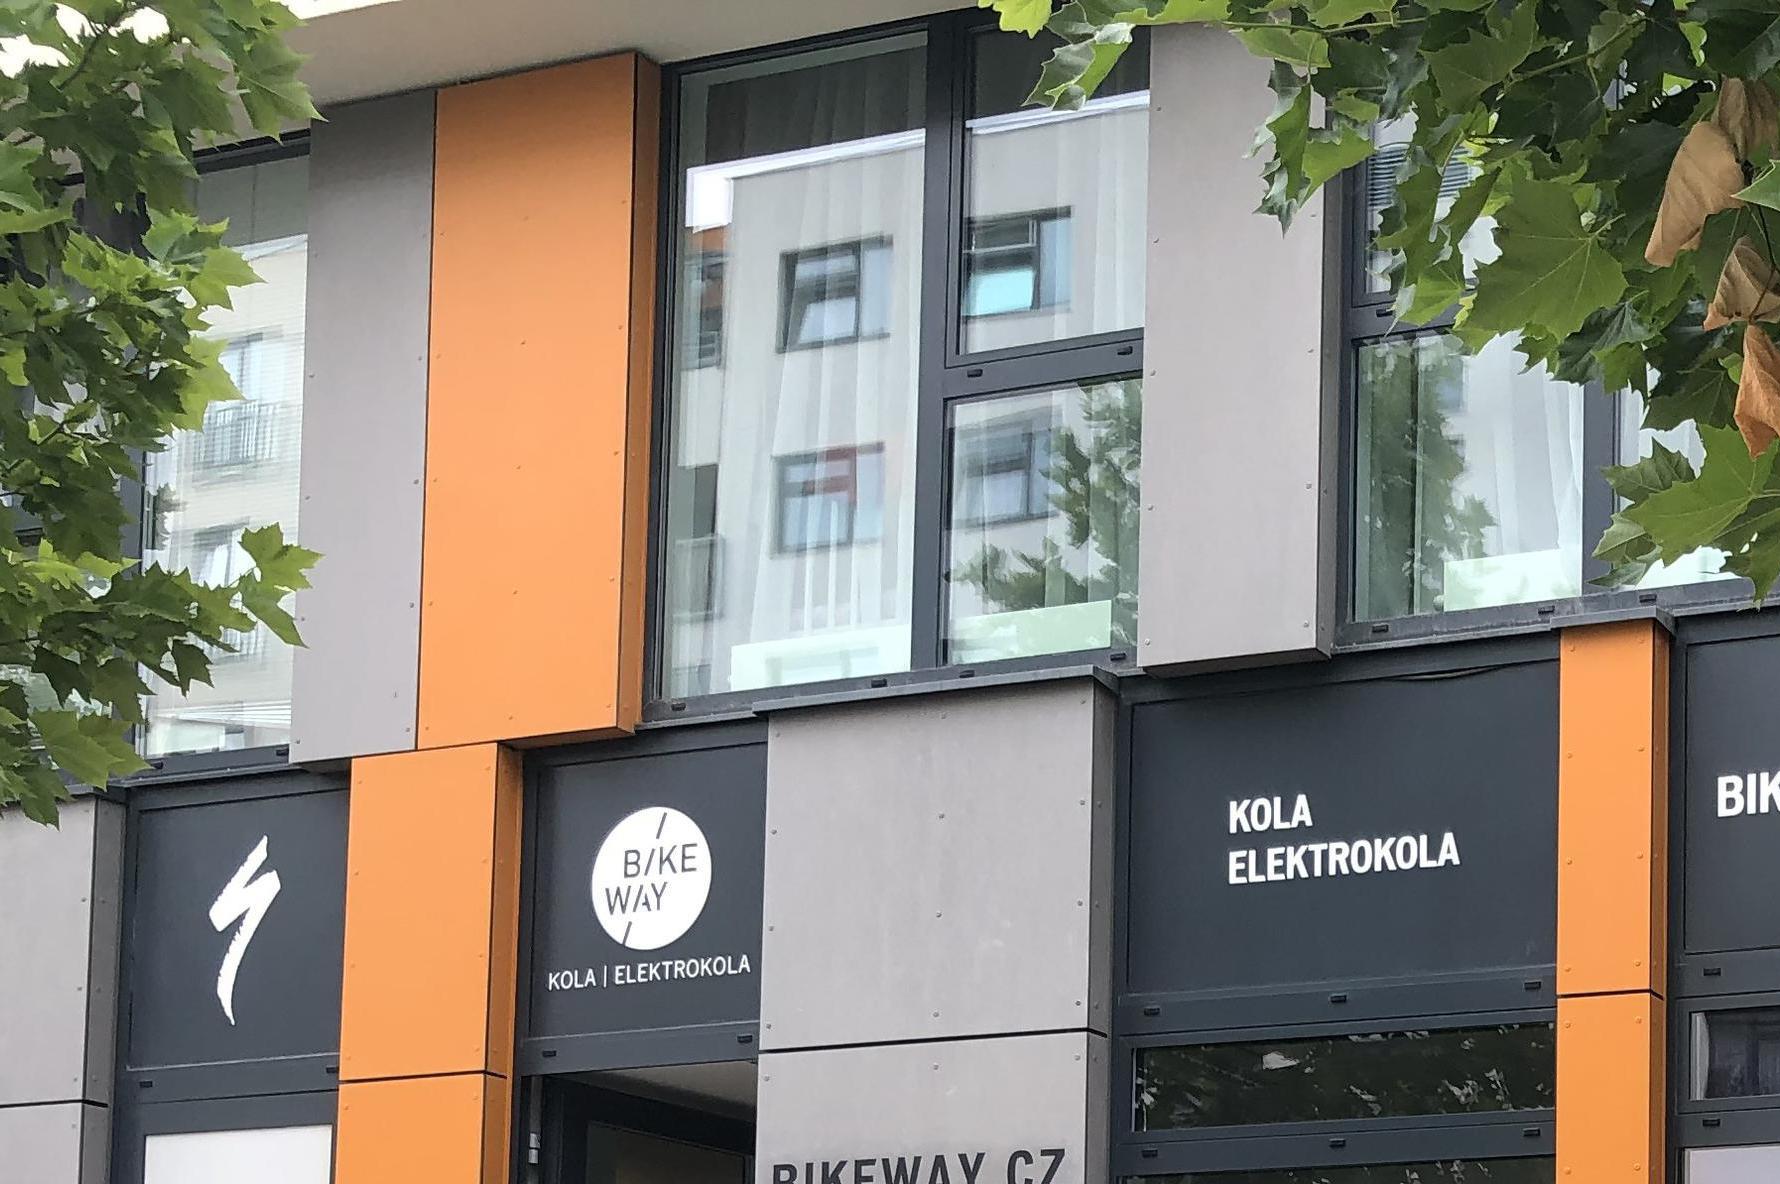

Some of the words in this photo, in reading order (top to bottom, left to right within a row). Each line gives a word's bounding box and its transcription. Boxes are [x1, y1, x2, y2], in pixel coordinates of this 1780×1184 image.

[1229, 794, 1313, 833] KOLA
[624, 843, 698, 879] BIKE
[1228, 832, 1460, 884] ELEKTROKOLA
[605, 882, 668, 915] WAY
[548, 968, 597, 991] KOLA
[614, 954, 751, 985] ELEKTROKOLA
